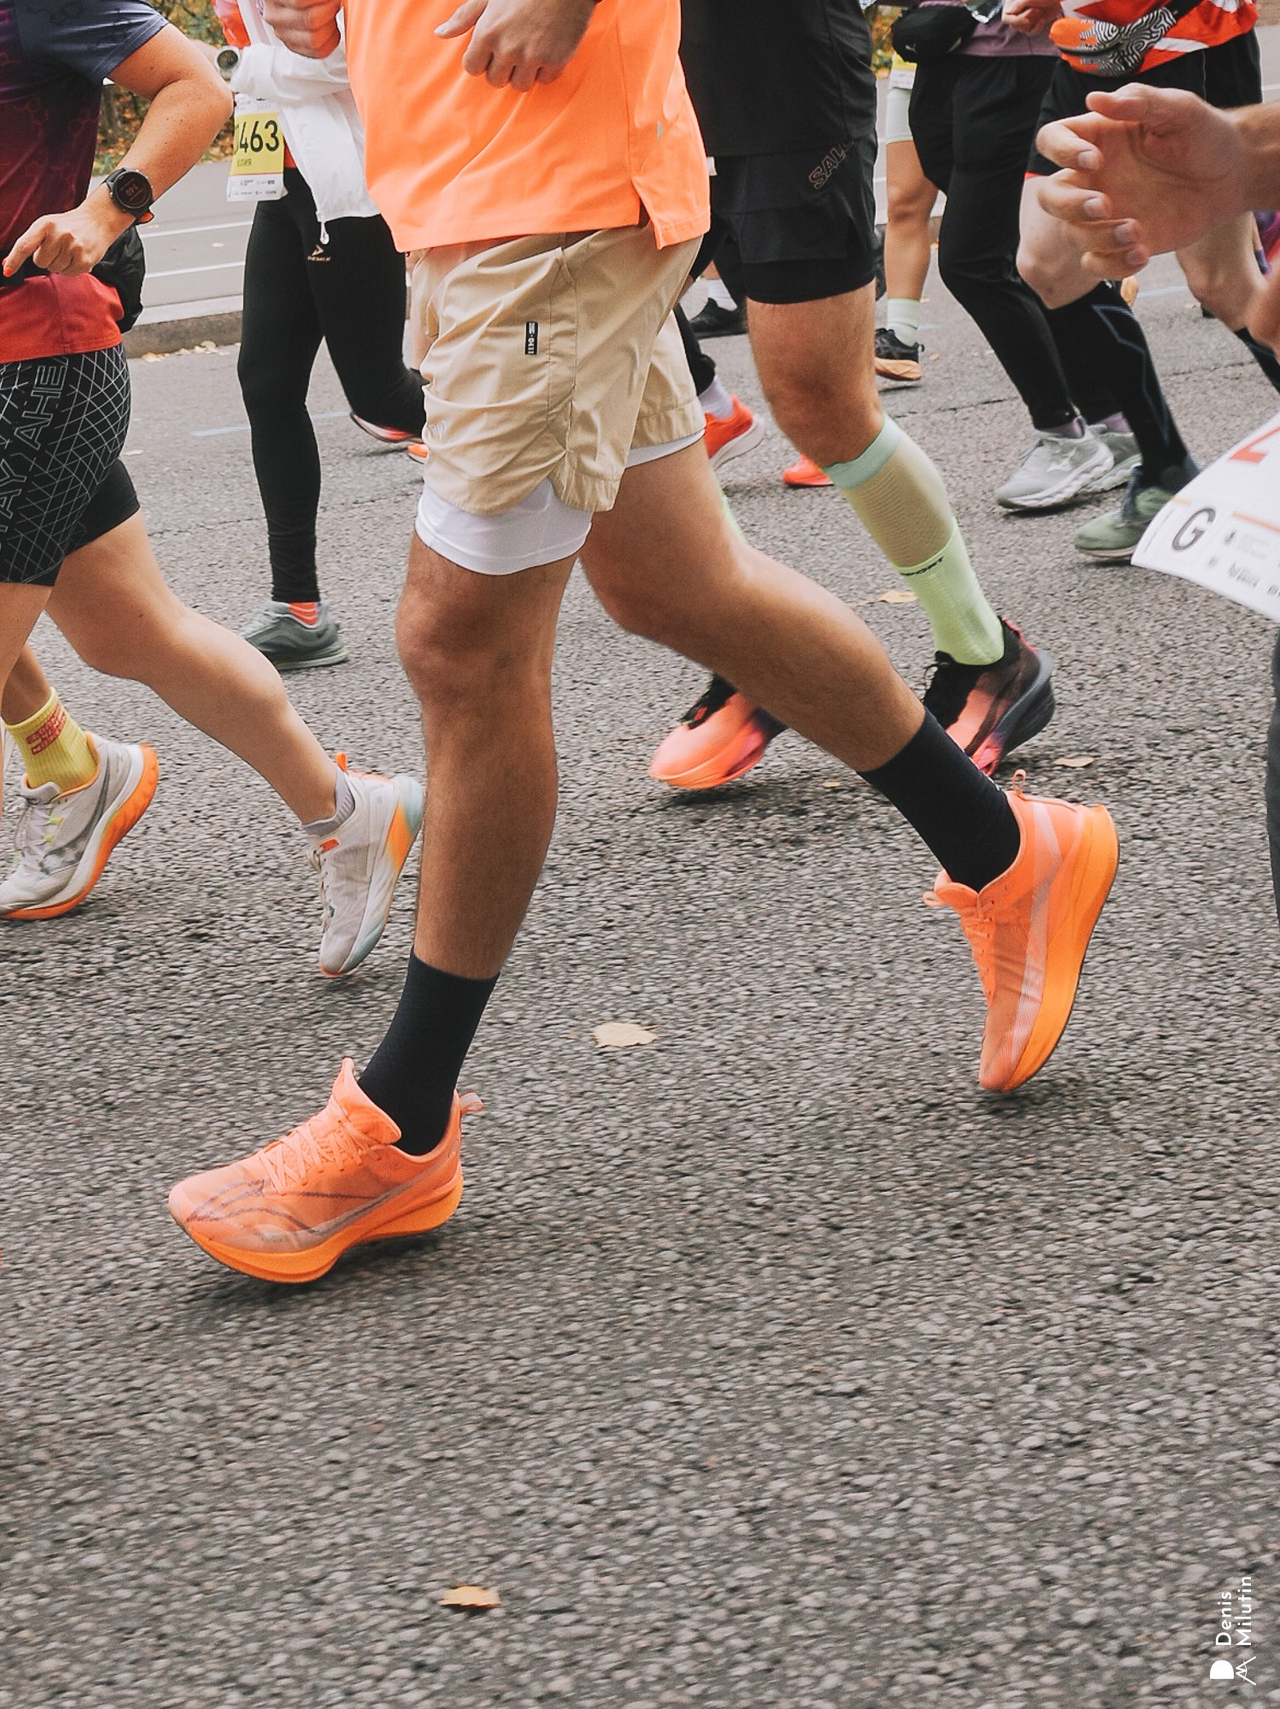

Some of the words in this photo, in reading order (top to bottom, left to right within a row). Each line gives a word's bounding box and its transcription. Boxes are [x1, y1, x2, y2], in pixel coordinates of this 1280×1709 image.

[236, 119, 280, 153] 463
[13, 356, 70, 450] AHE
[1172, 507, 1216, 552] G
